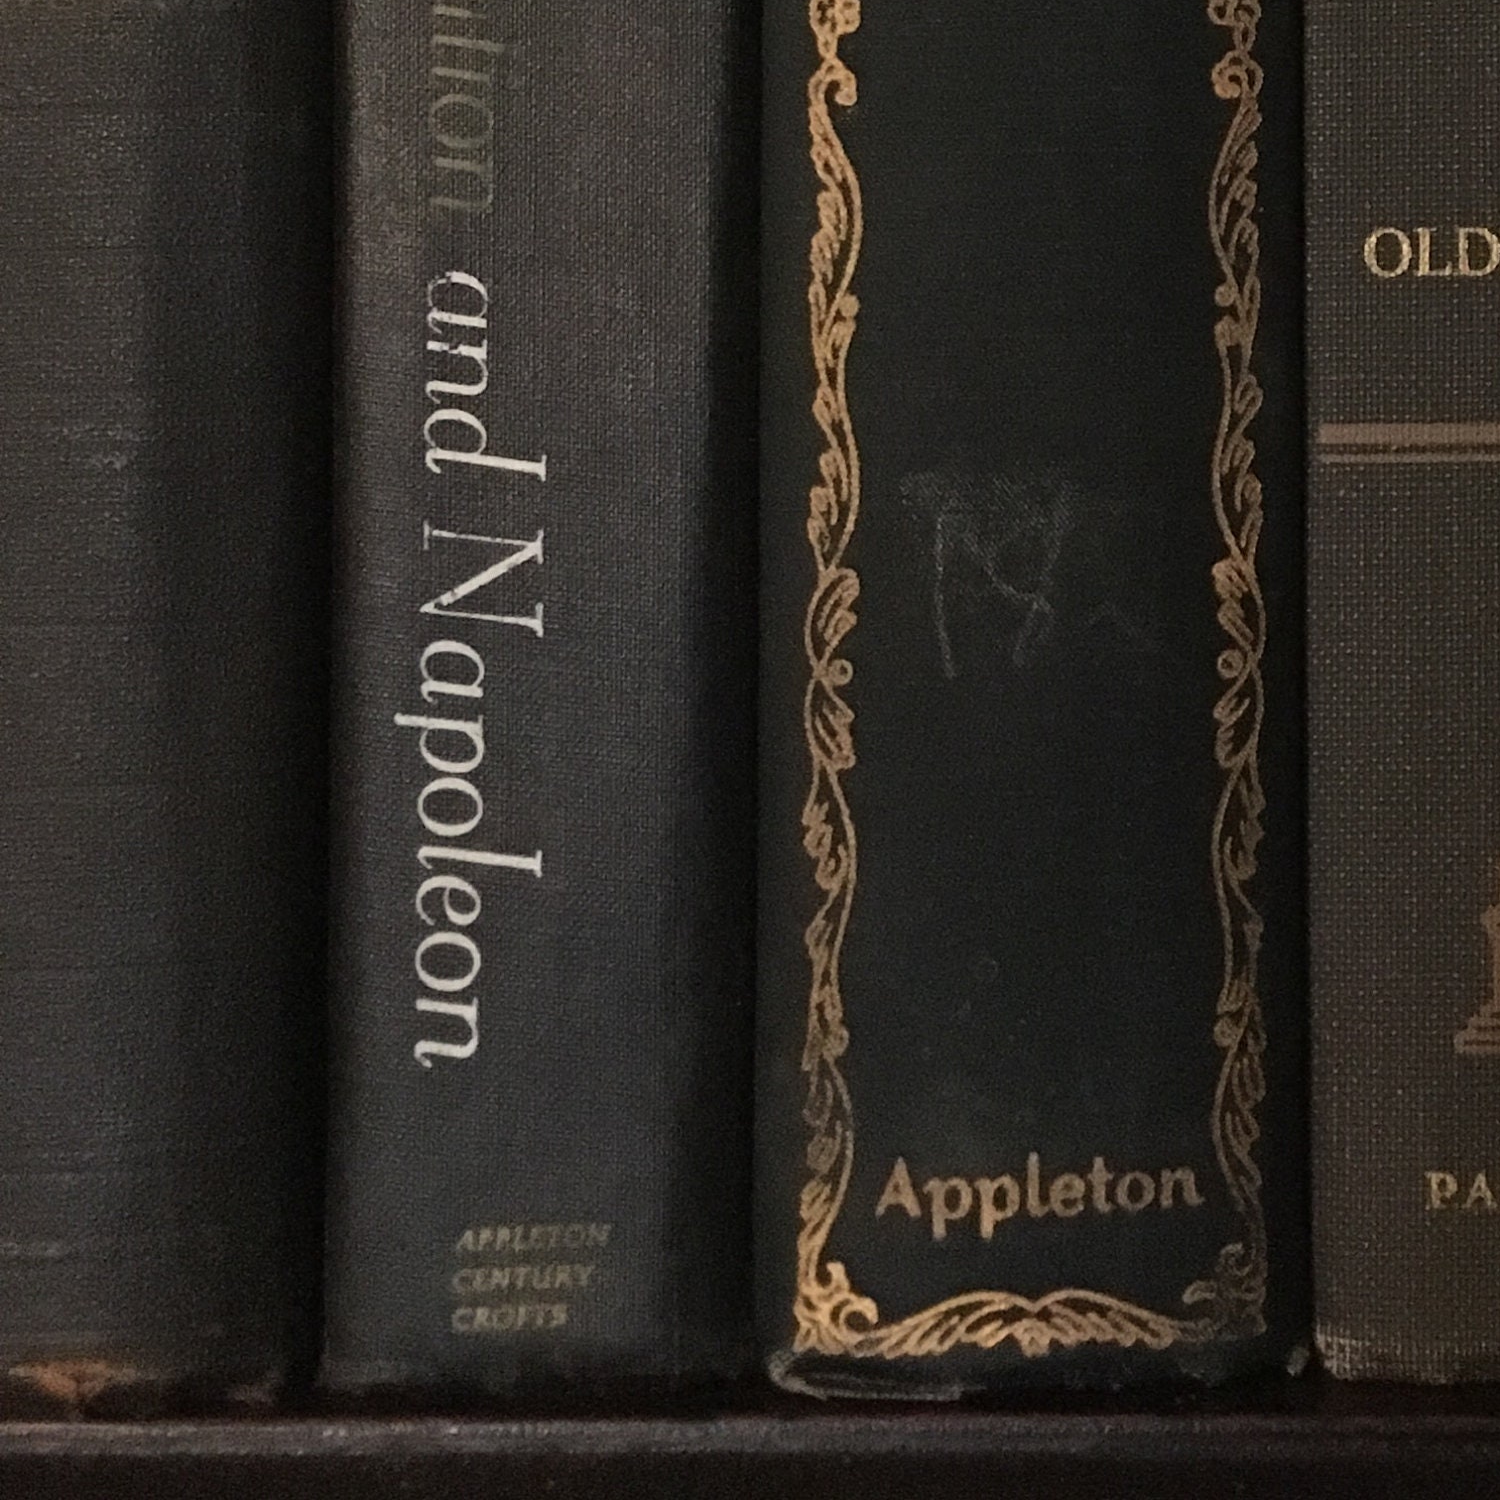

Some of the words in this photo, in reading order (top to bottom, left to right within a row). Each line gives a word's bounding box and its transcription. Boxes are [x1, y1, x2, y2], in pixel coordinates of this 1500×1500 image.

[422, 269, 548, 482] and
[394, 519, 546, 1072] Napoleon
[455, 1222, 614, 1253] APPLETON
[874, 1150, 1204, 1241] Appleton
[451, 1262, 596, 1294] CENTURY
